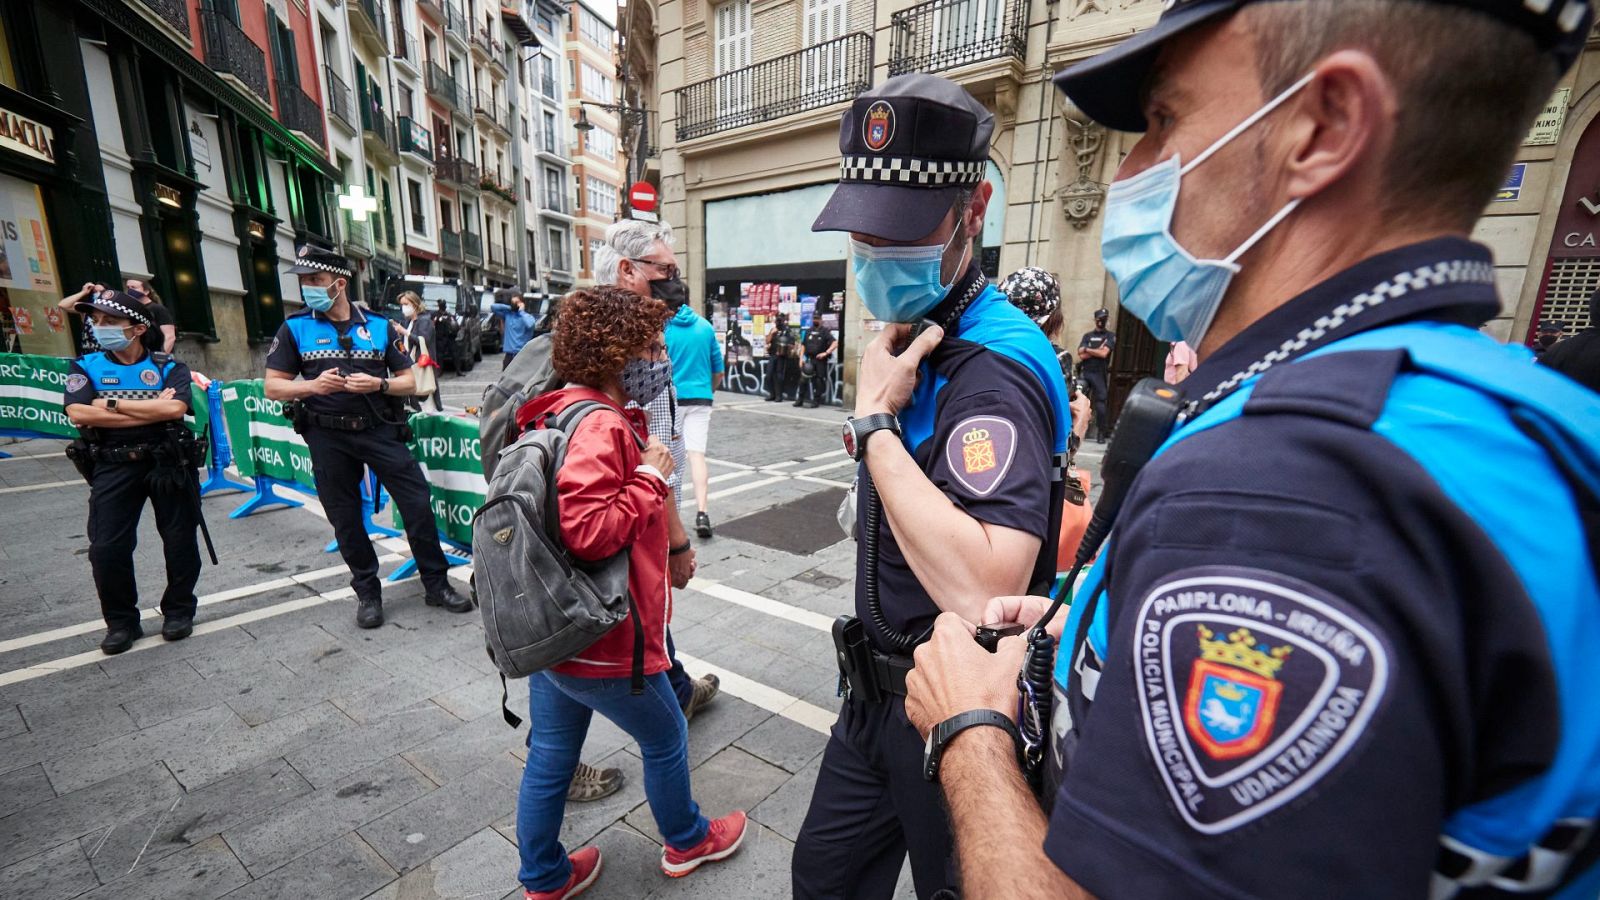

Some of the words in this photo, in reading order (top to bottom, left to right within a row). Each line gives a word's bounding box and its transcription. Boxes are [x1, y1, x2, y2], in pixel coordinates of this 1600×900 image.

[1564, 232, 1596, 247] CA
[1142, 619, 1165, 698] POLICIA
[1150, 699, 1204, 811] MUNICIPAL
[1229, 685, 1365, 806] UDALTZAINGOA
